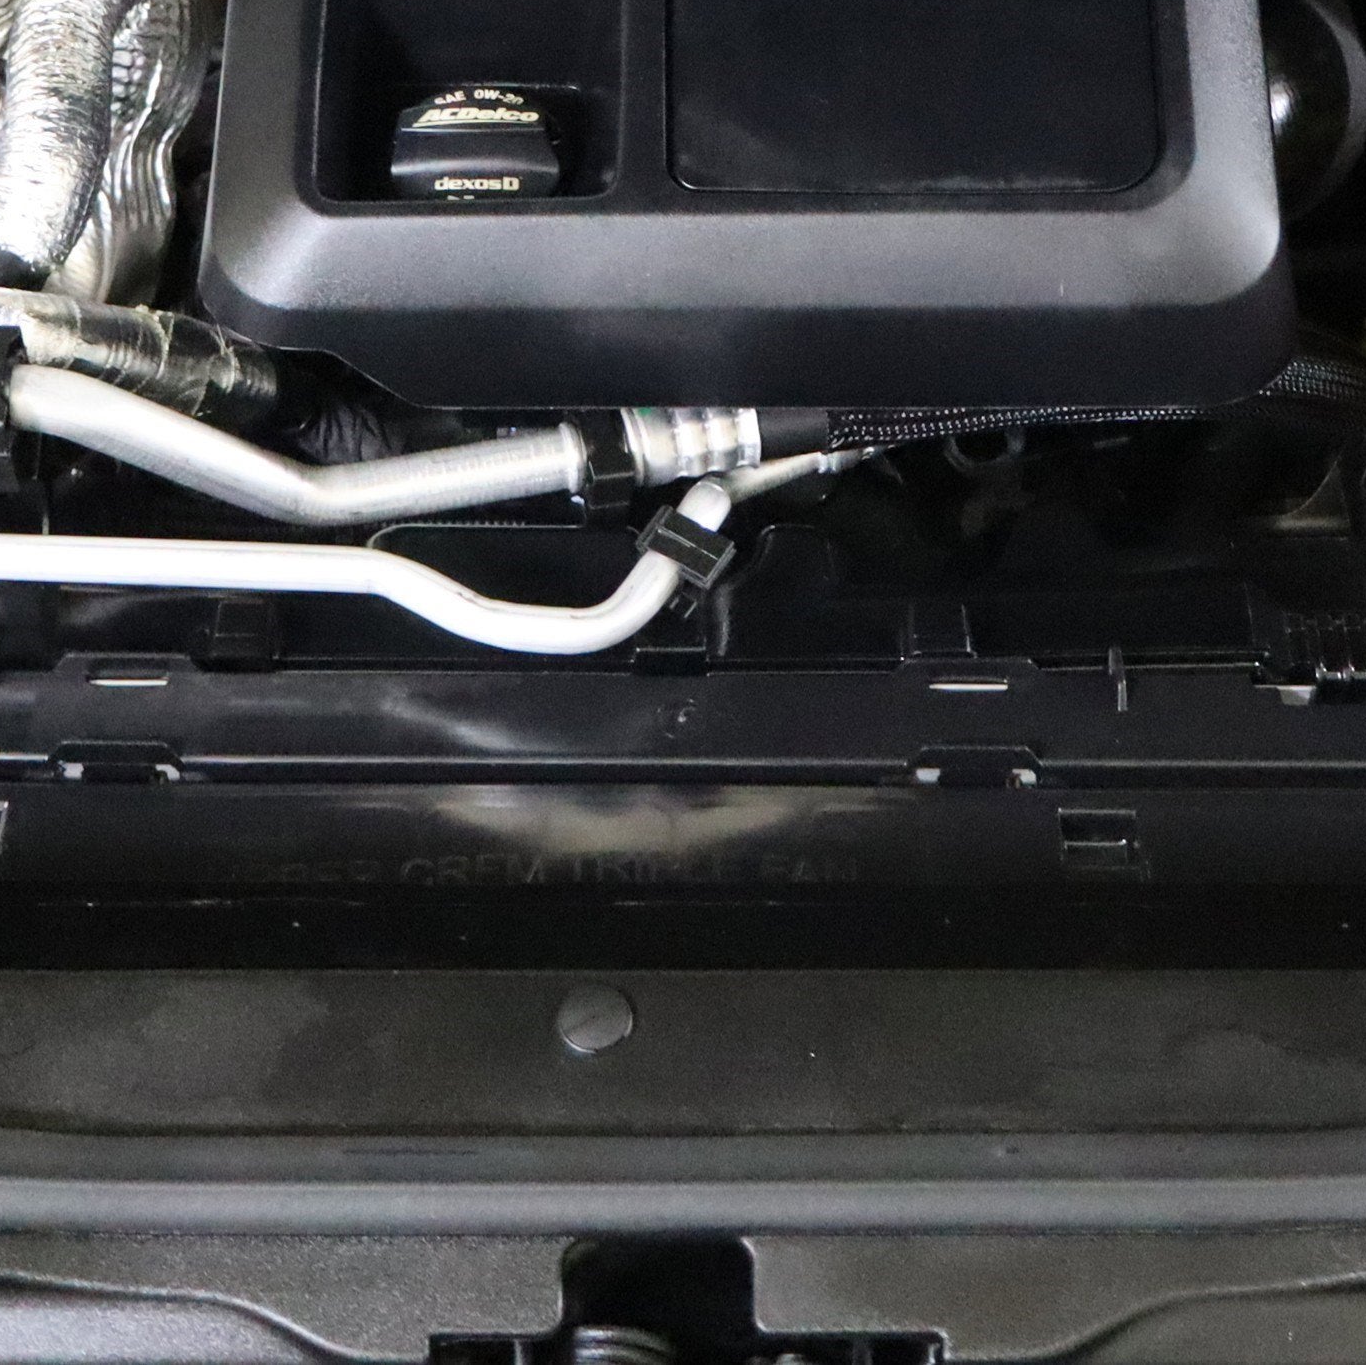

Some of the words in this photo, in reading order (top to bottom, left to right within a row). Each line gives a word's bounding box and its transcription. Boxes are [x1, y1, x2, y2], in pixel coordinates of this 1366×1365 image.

[434, 90, 467, 105] SAE
[417, 107, 540, 124] ACDelco
[433, 176, 521, 191] dexosD
